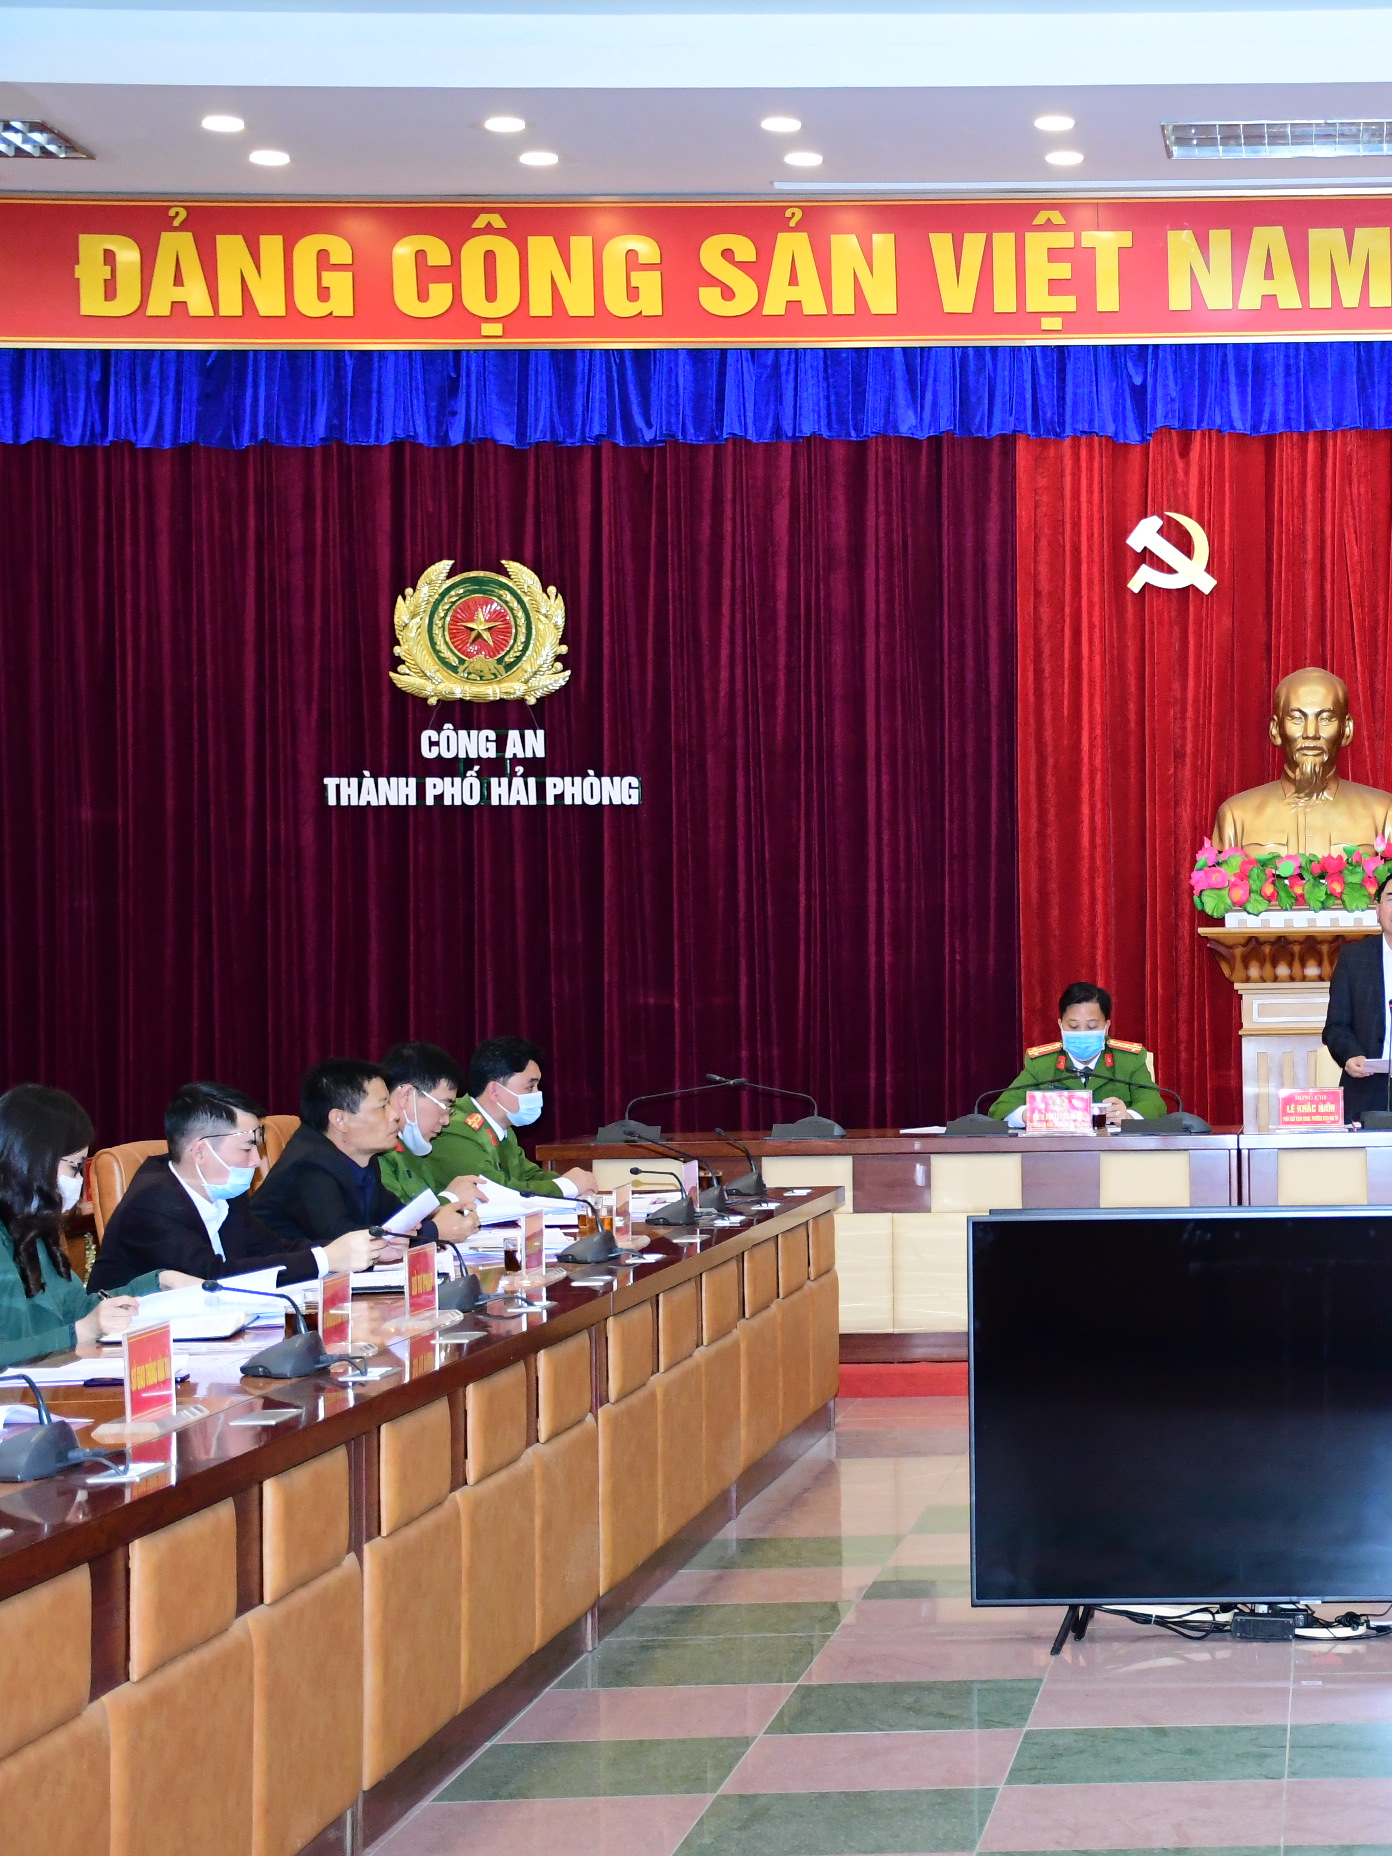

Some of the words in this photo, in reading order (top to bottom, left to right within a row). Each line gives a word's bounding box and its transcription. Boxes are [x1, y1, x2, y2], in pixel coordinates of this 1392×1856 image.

[76, 207, 353, 317] ĐẢNG
[393, 214, 662, 335] CỘNG
[699, 208, 897, 316] SẢN
[931, 211, 1132, 330] VIỆT
[1169, 227, 1391, 310] NAM
[421, 724, 496, 758] CÔNG
[505, 730, 545, 758] AN
[324, 771, 416, 805] THÀNH
[426, 766, 480, 805] PHỐ
[491, 762, 536, 805] HẢI
[546, 770, 638, 805] PHÒNG
